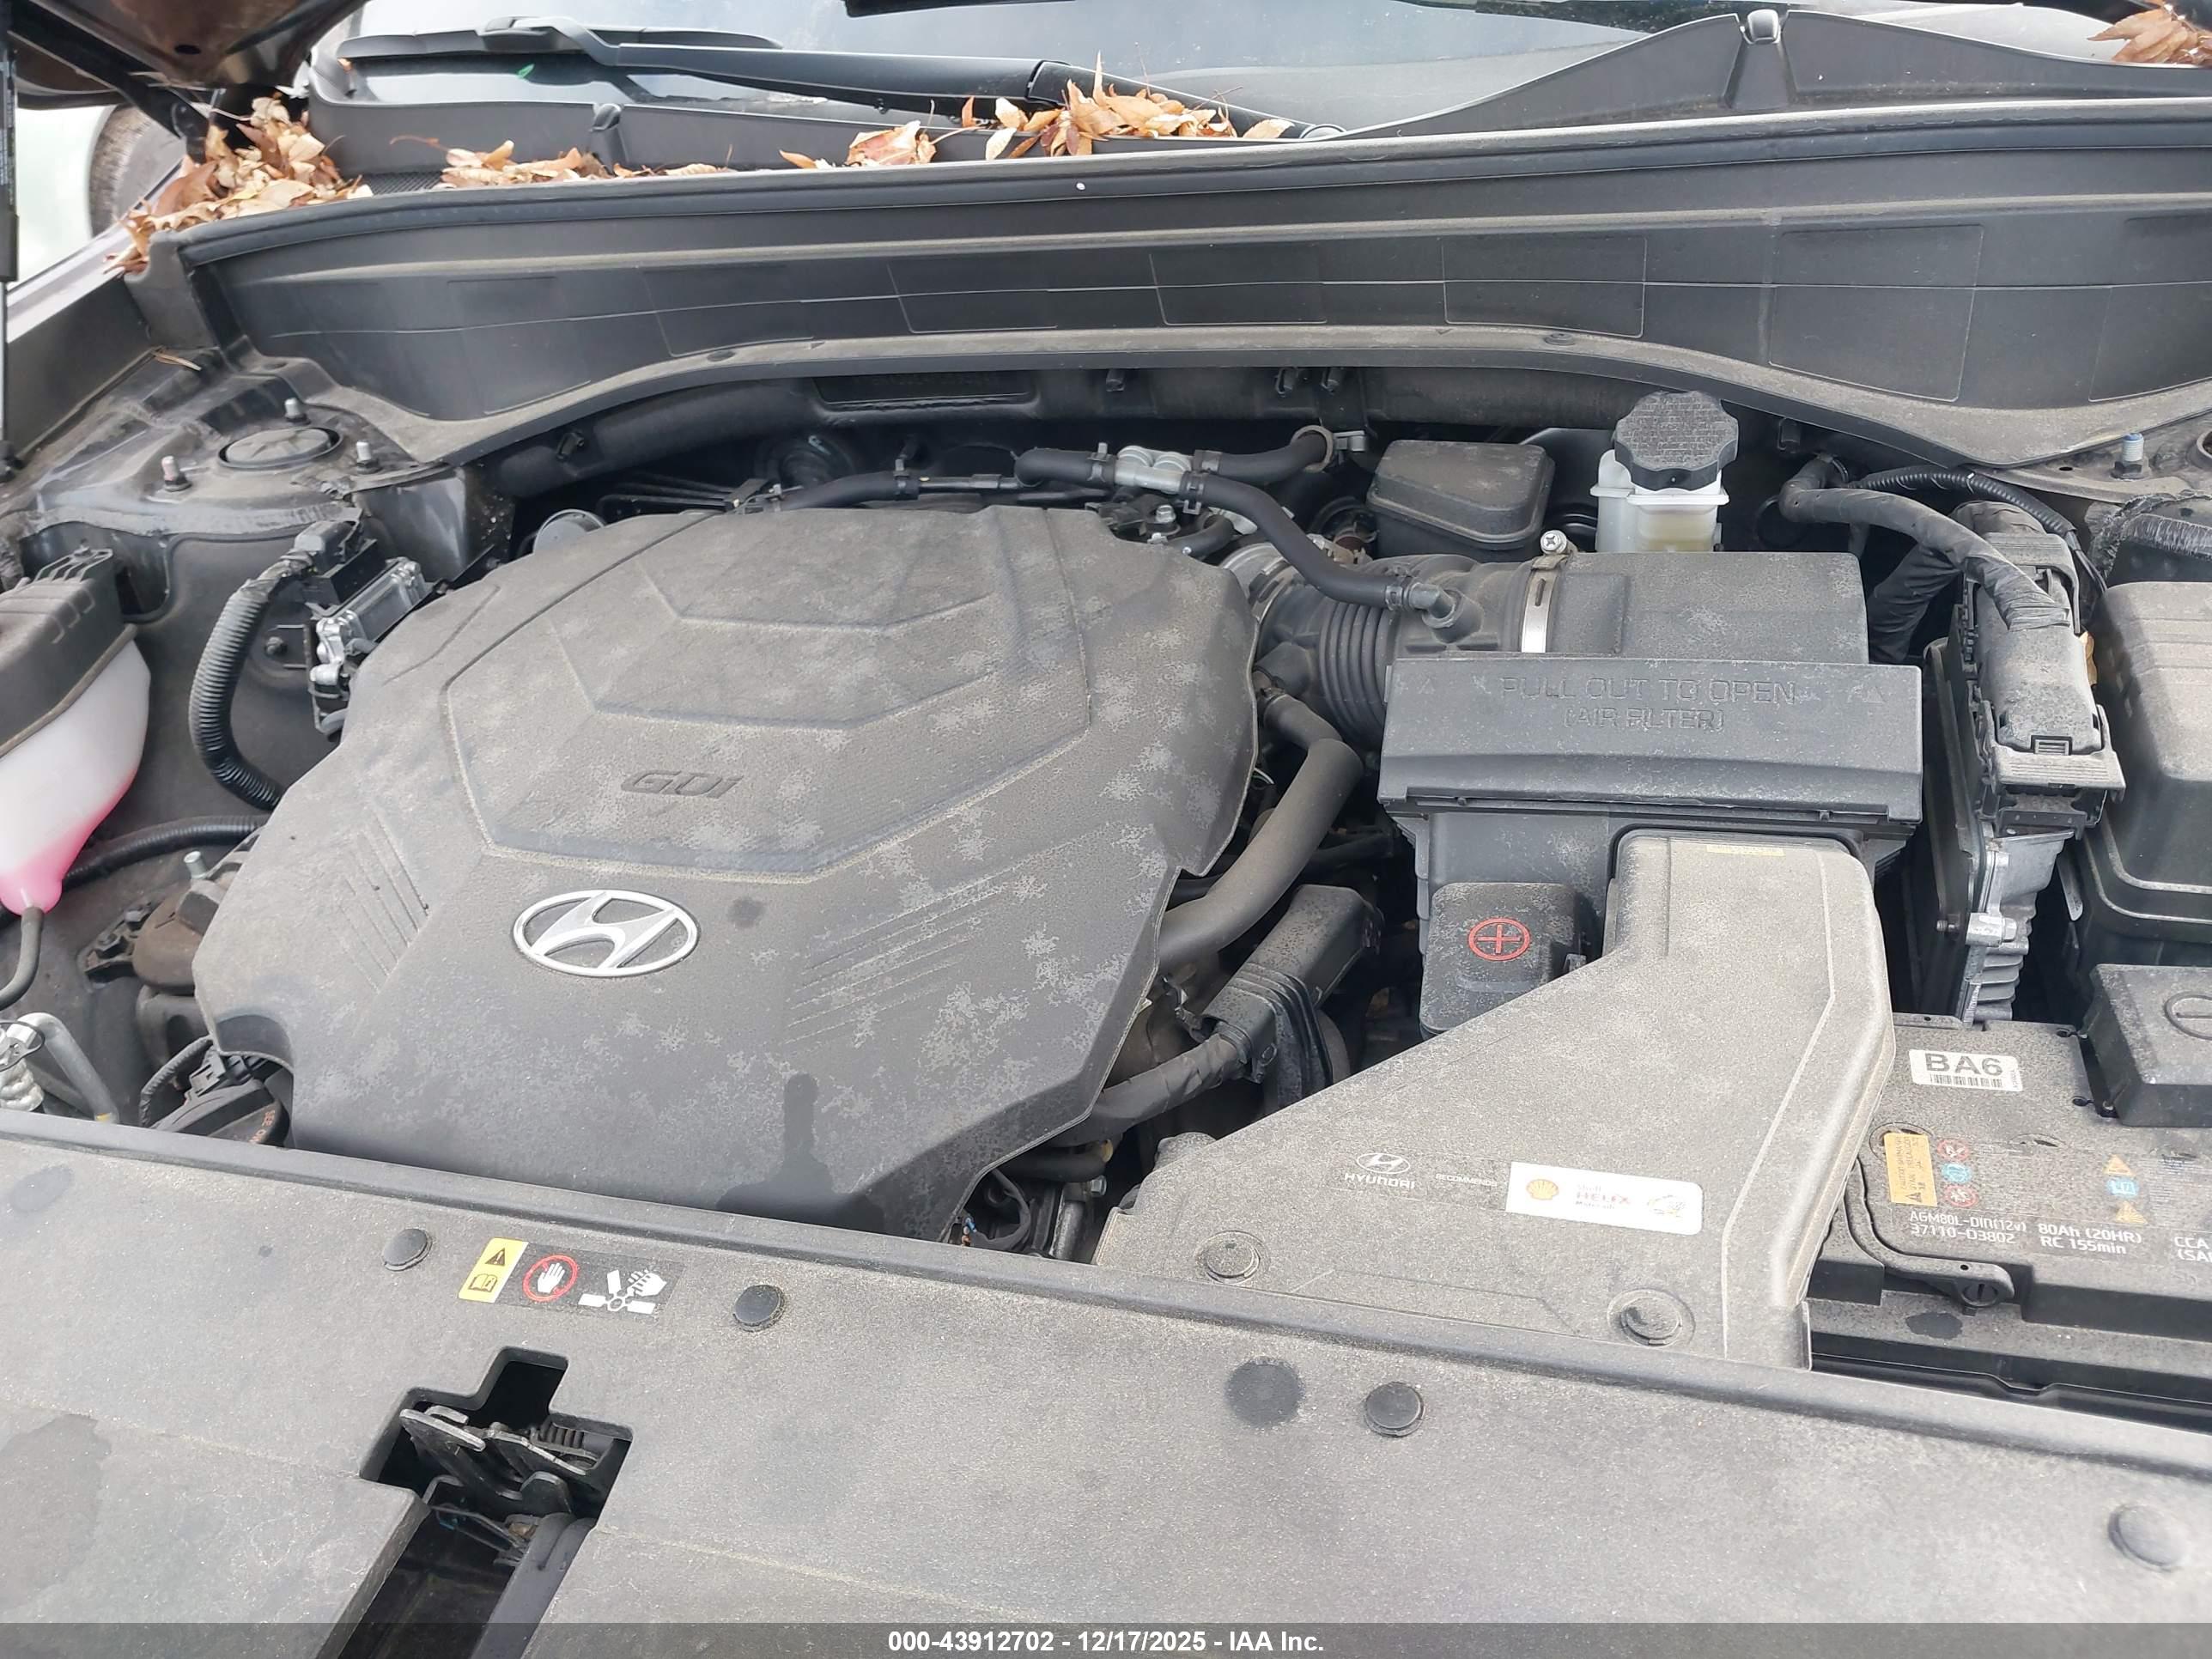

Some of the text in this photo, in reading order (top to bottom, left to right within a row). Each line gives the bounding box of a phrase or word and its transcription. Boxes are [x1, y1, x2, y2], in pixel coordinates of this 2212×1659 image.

[1500, 677, 1796, 705] PULL OUT TO OPEN
[621, 770, 744, 799] GDI
[1925, 1053, 2003, 1076] BA6
[1344, 1172, 1415, 1189] HYUNDAI
[1436, 1173, 1498, 1188] RECOMMENDS
[1910, 1223, 2016, 1244] 37110-D3802
[2038, 1223, 2142, 1244] 80Ah (20HR)
[2174, 1236, 2210, 1250] CCA
[2040, 1236, 2127, 1255] RC 155min
